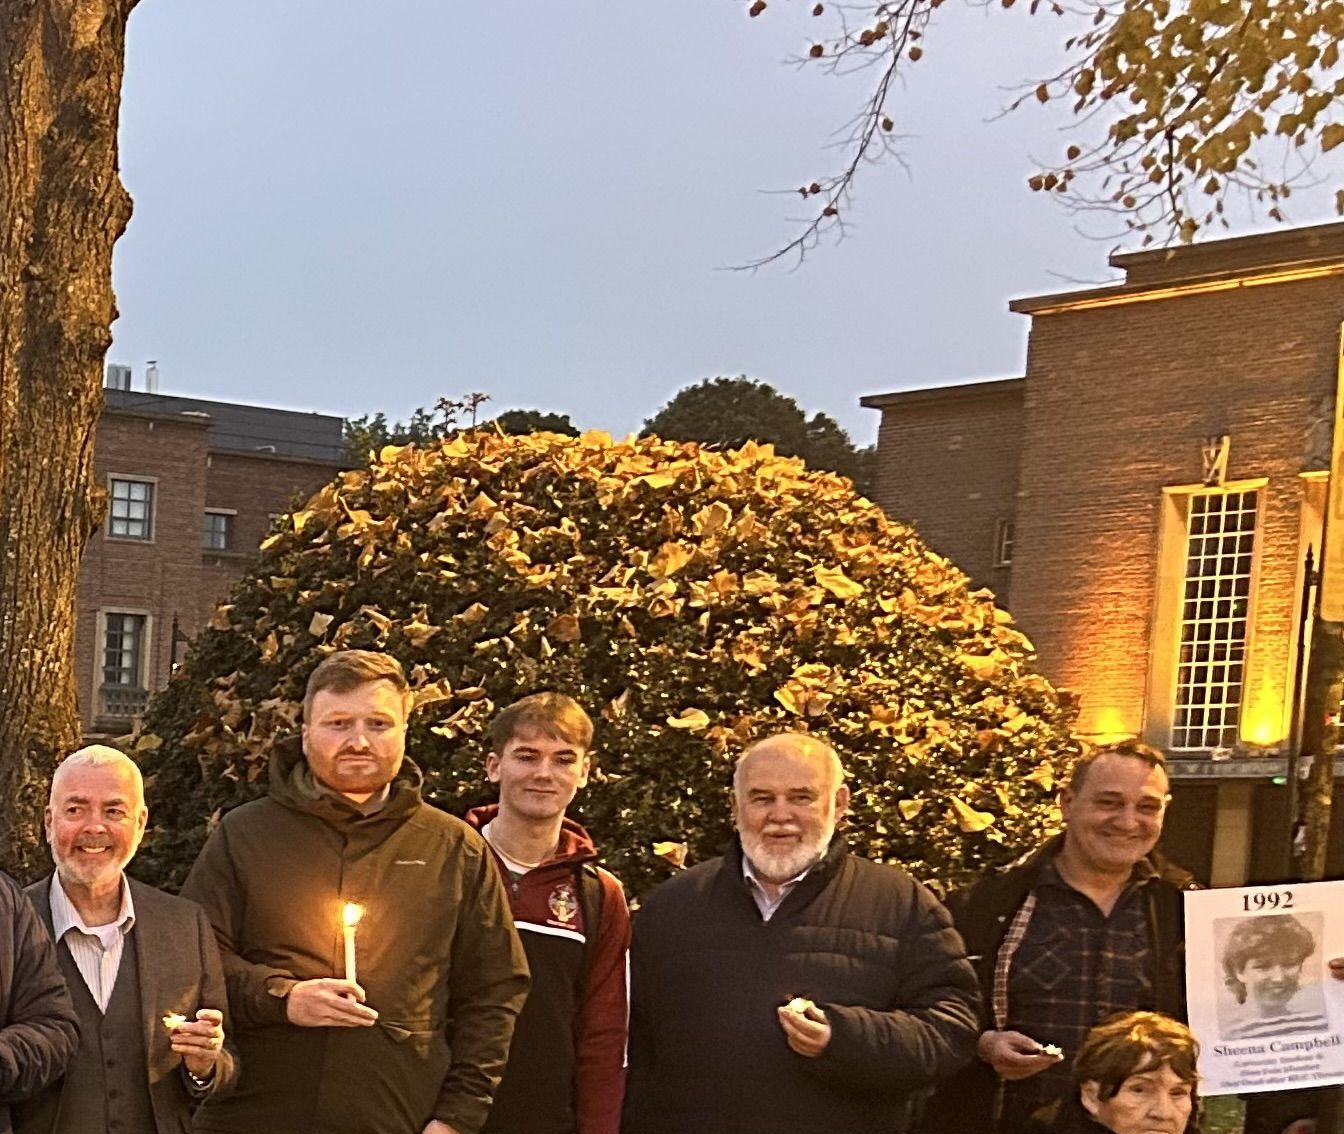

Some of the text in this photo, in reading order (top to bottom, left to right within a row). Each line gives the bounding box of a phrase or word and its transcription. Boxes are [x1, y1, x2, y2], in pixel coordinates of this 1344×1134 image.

[1242, 890, 1294, 911] 1992
[1213, 1034, 1341, 1057] Sheena Campbell
